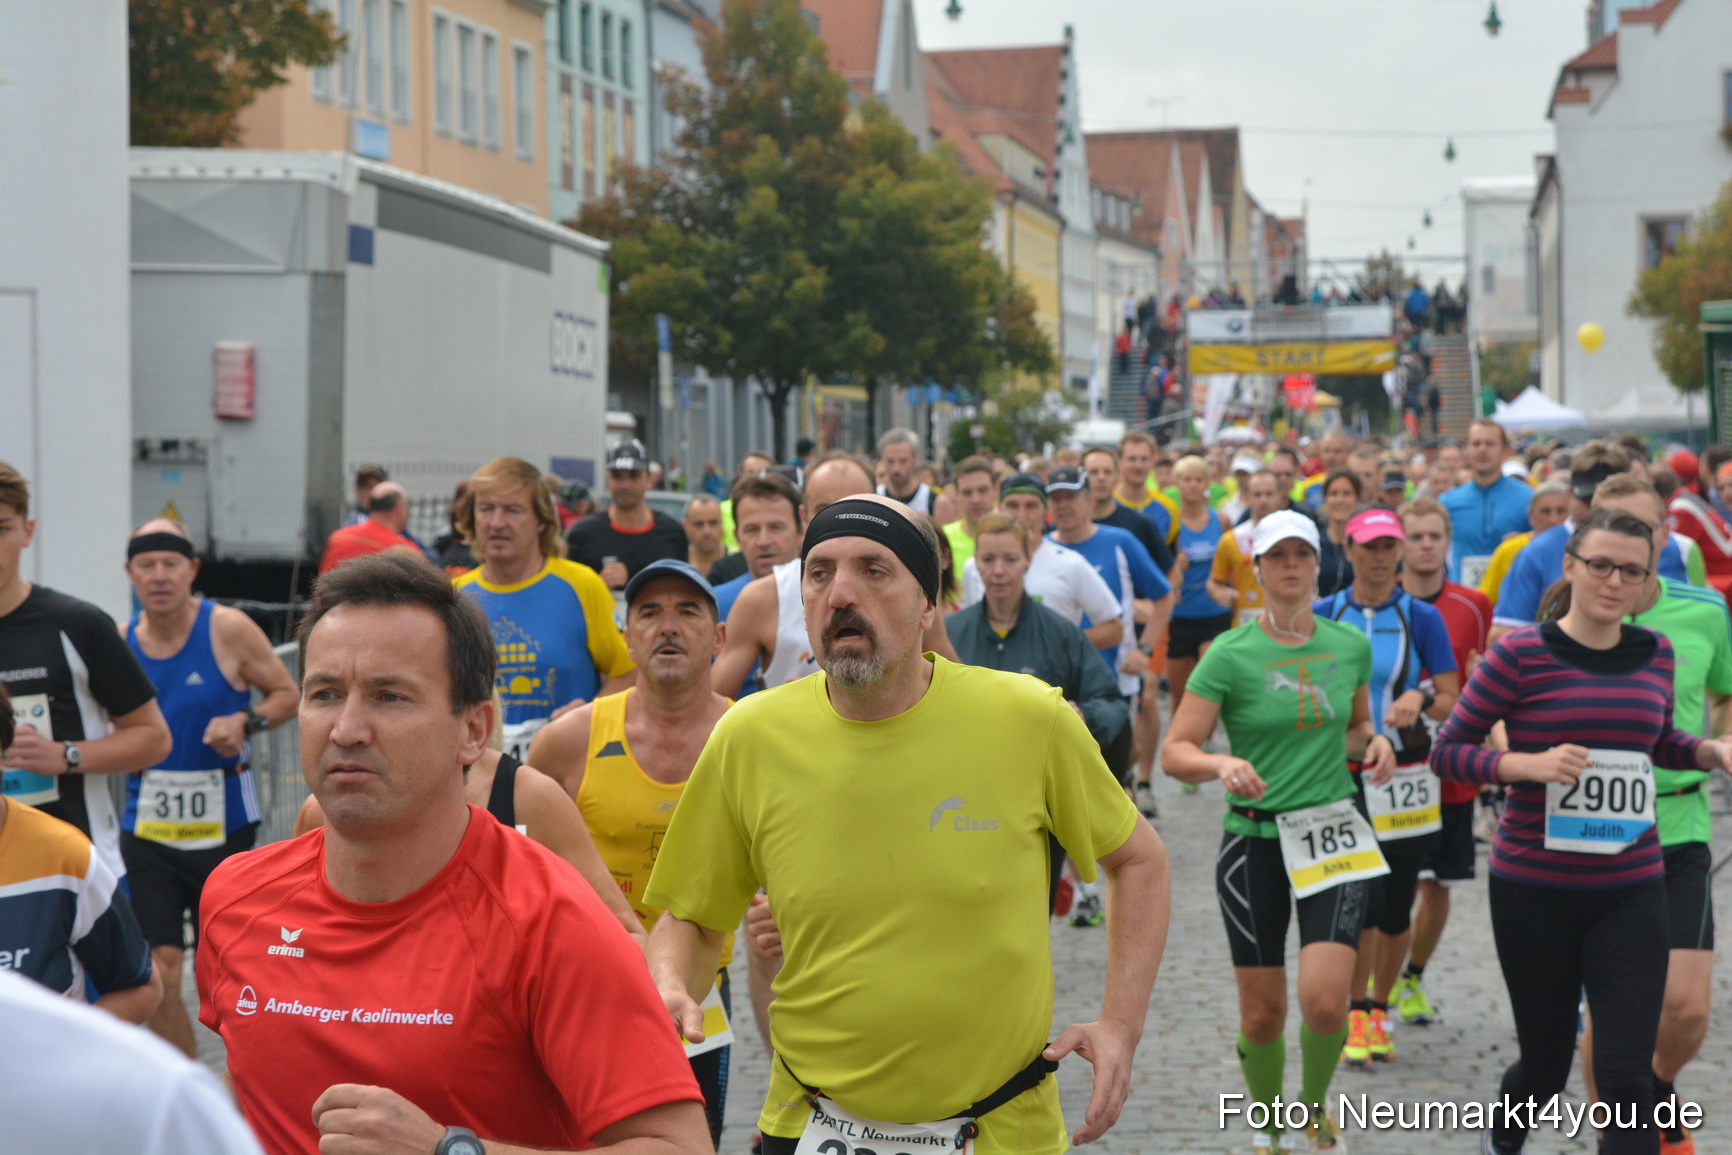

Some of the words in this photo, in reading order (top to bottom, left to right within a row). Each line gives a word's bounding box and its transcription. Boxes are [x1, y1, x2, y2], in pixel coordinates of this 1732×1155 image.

[1256, 349, 1326, 367] START
[155, 791, 206, 818] 310
[1384, 779, 1429, 809] 125
[1559, 775, 1646, 814] 2900
[953, 816, 999, 832] Claus
[1580, 822, 1625, 838] Judith
[1301, 821, 1357, 860] 185
[267, 944, 305, 958] erima
[263, 998, 349, 1023] Amberger
[351, 1007, 454, 1025] Kaolinwerke
[861, 1126, 947, 1147] Neumarkt
